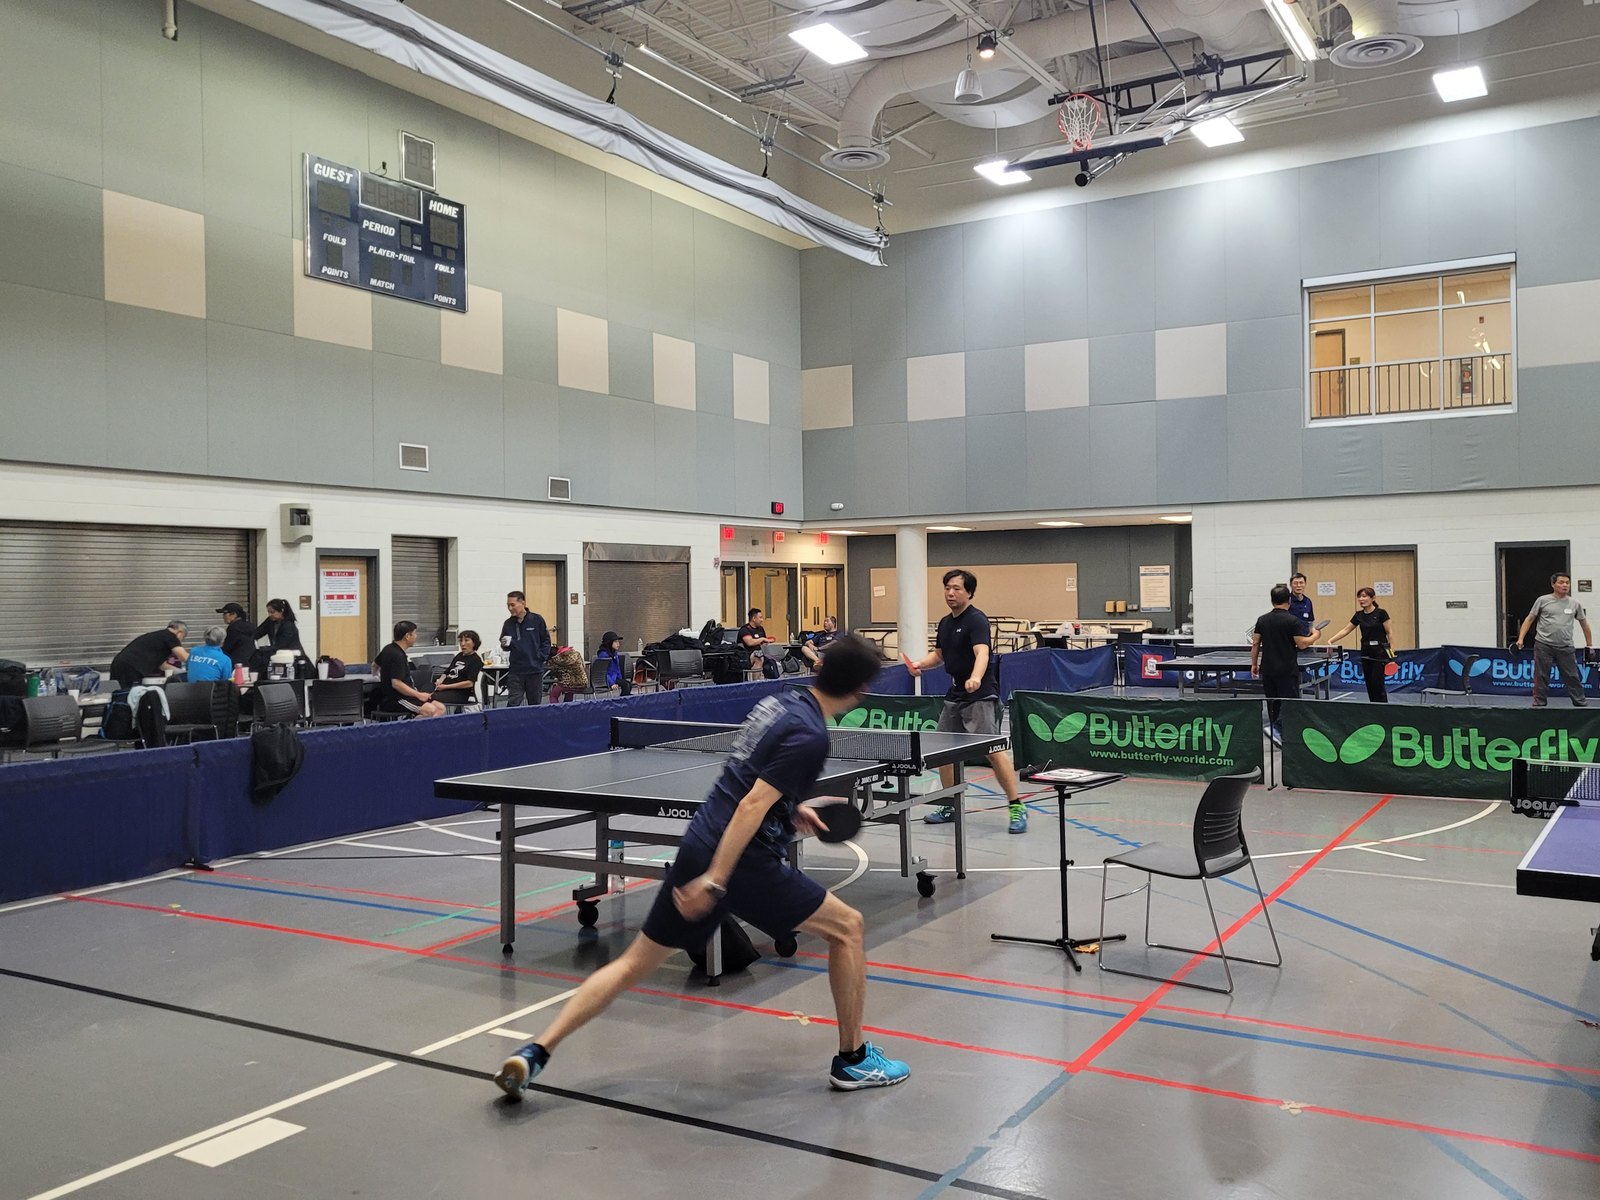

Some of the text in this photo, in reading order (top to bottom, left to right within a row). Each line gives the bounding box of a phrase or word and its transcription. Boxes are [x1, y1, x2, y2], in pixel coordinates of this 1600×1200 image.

[313, 162, 354, 184] GUEST
[428, 199, 459, 218] HOME
[362, 219, 396, 237] PERIOD
[322, 232, 347, 246] FOULS
[368, 245, 416, 264] PLAYER-FOUL
[321, 265, 349, 279] POINTS
[434, 262, 455, 274] FOULS
[369, 277, 395, 290] MATCH
[433, 293, 457, 305] POINTS
[1089, 712, 1233, 757] Butterfly
[1089, 750, 1234, 766] www.butterfly-world.com
[1516, 798, 1558, 811] JOOLA
